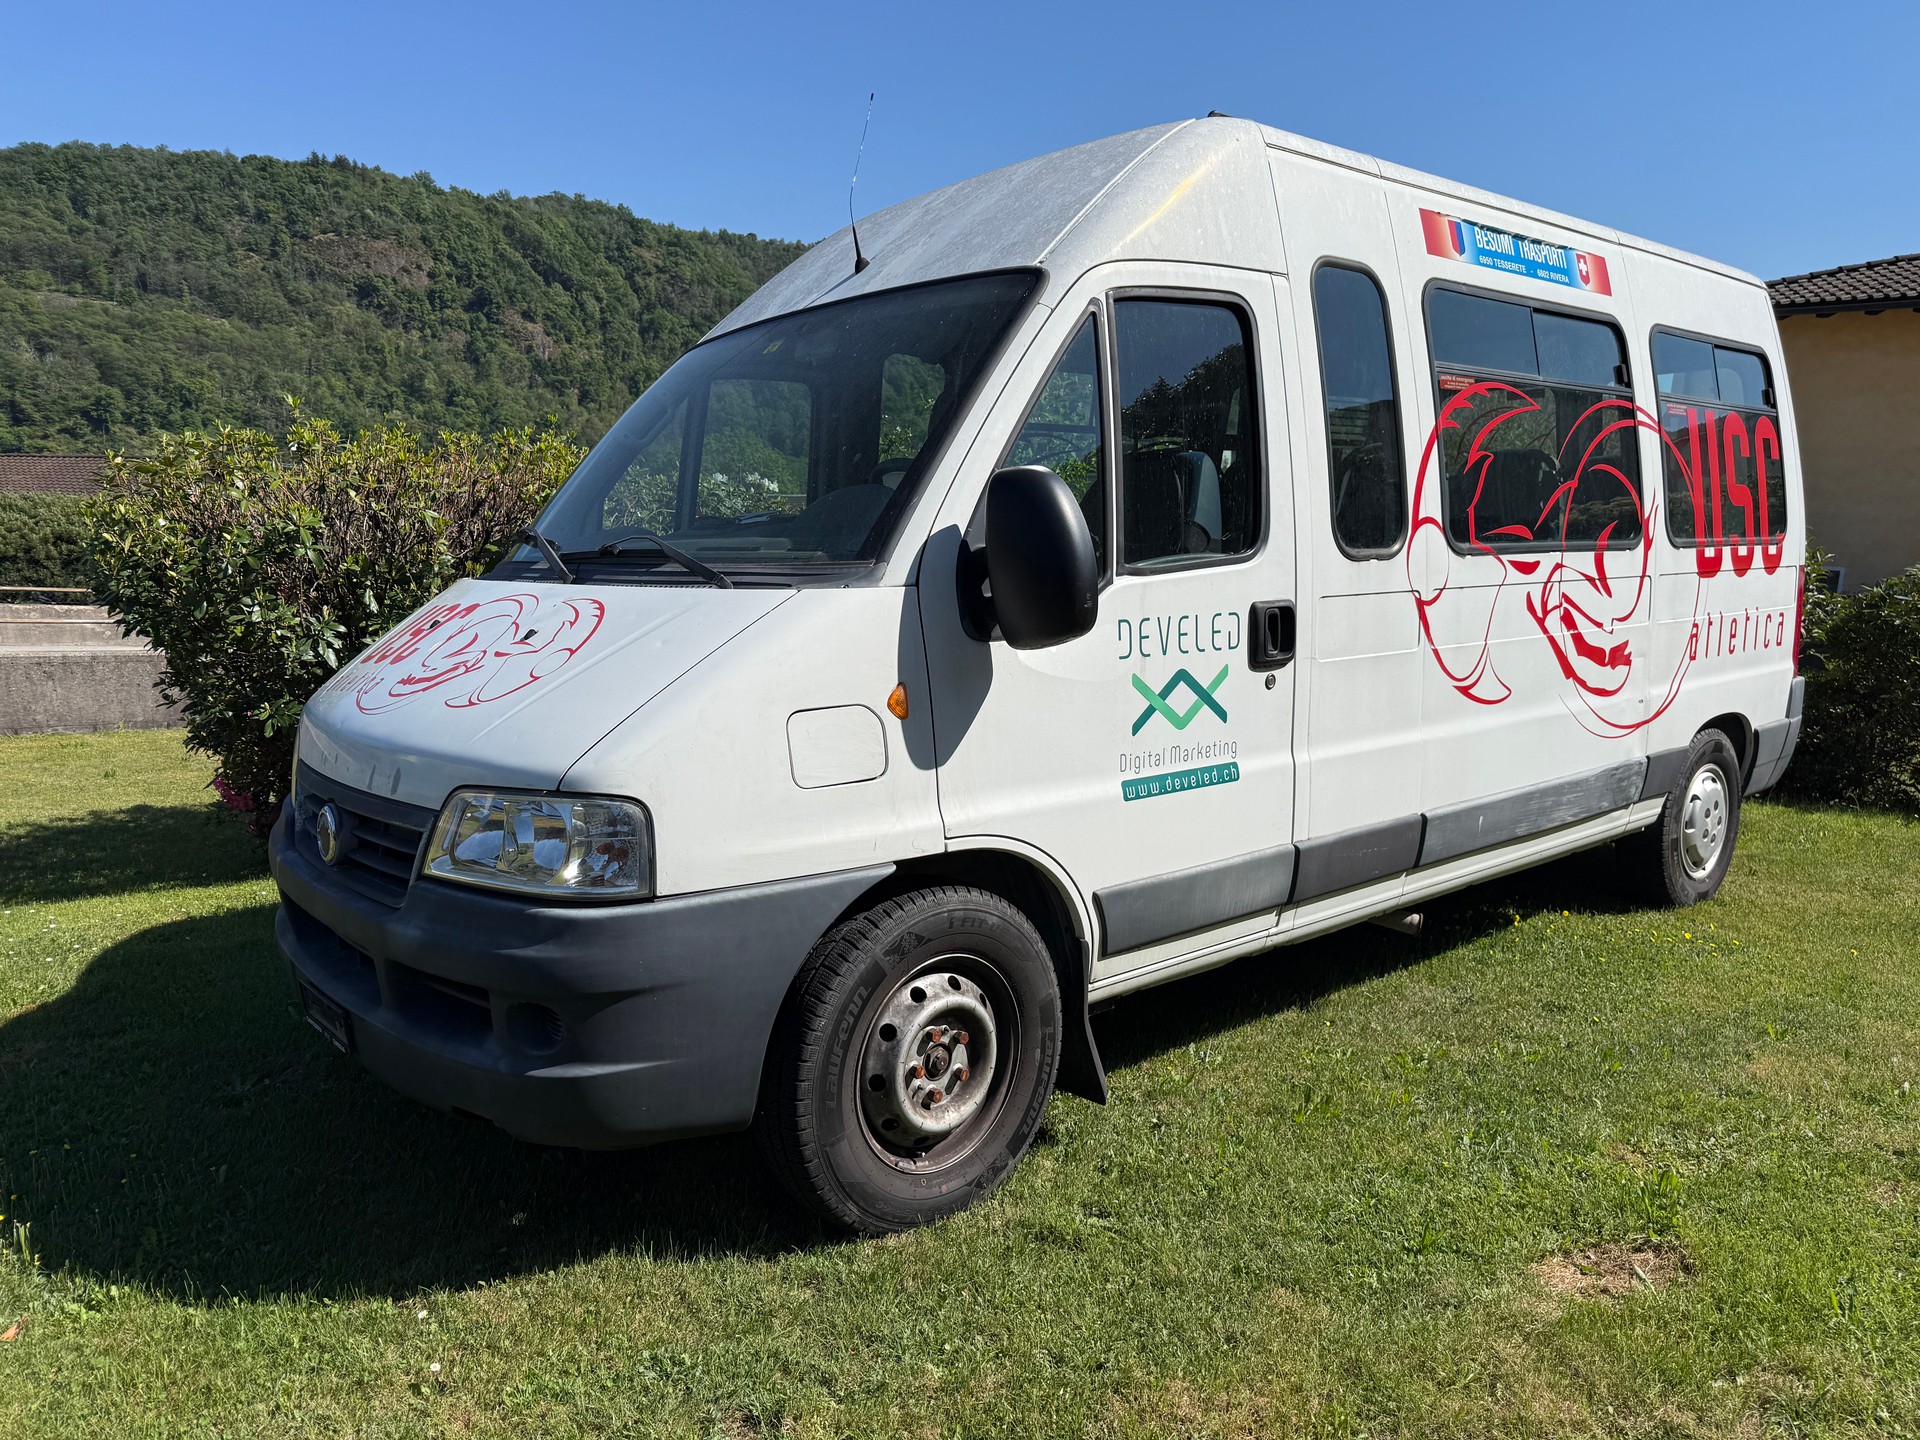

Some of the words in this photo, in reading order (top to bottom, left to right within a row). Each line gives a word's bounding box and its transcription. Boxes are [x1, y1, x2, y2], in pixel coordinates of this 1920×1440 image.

[1479, 254, 1493, 266] 6950
[1494, 258, 1526, 273] TESSERETE
[1550, 272, 1569, 284] RIVERA
[1519, 239, 1567, 269] TRASPORTI
[1686, 407, 1786, 578] USC
[1117, 611, 1240, 660] DEVELED
[1688, 606, 1785, 661] atletica
[1119, 747, 1167, 774] Digital
[1170, 740, 1238, 765] Marketing
[1125, 766, 1238, 798] www.develed.ch
